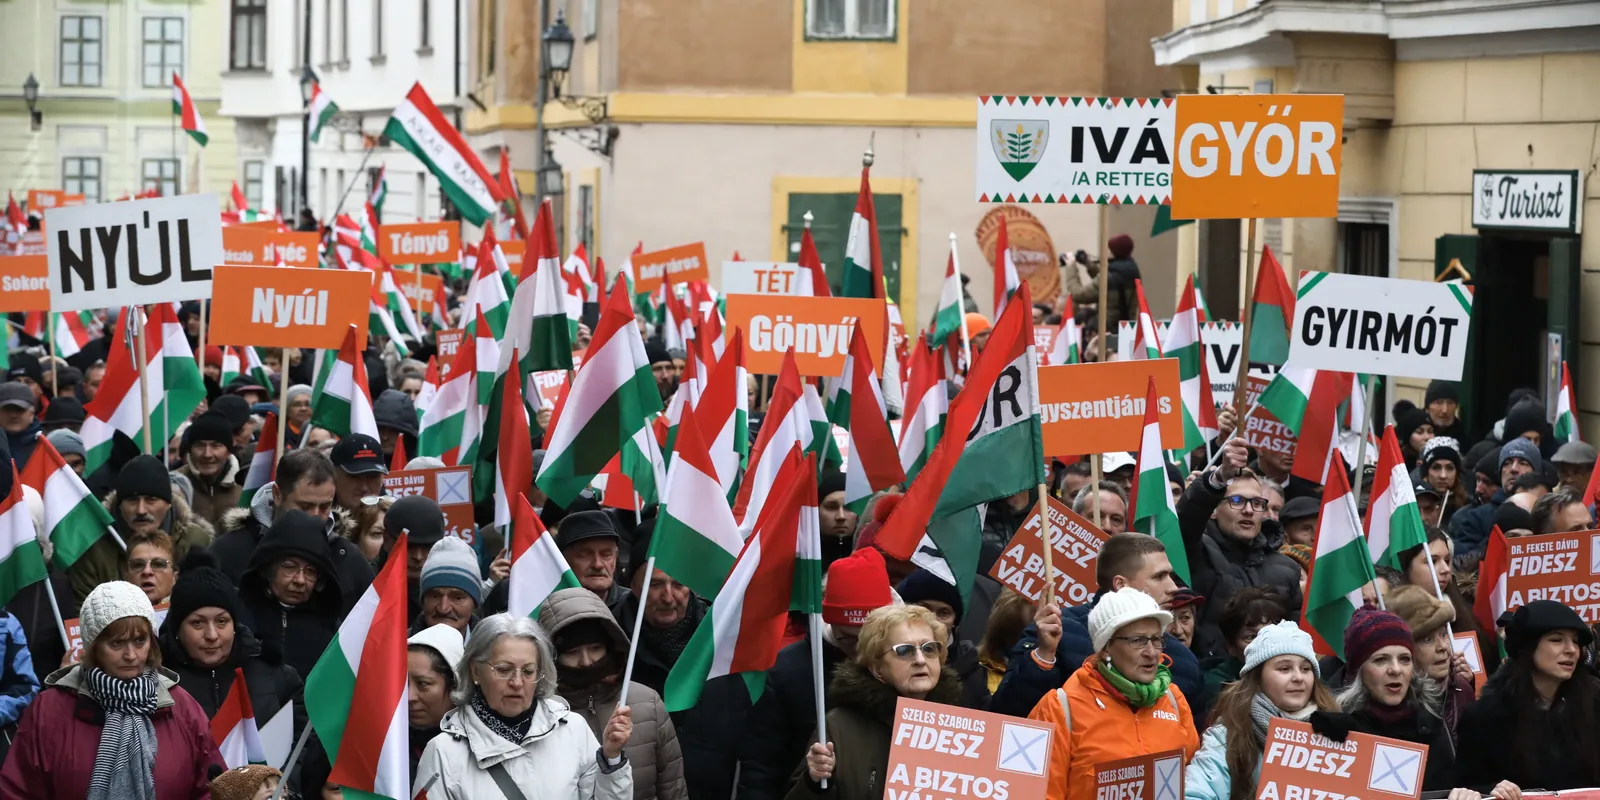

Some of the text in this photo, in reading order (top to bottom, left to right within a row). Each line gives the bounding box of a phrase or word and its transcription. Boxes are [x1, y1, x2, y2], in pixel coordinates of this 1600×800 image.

[1178, 105, 1336, 178] GYŐR
[1096, 171, 1173, 187] RETTEG
[1498, 176, 1564, 219] Turiszt
[58, 210, 212, 294] NYÚL
[389, 229, 449, 255] Tényő
[754, 265, 794, 293] TÉT
[251, 287, 328, 328] Nyúl
[749, 314, 857, 358] Gönyű
[1301, 305, 1459, 358] GYIRMÓT
[1040, 394, 1172, 425] gyszentjáns
[404, 474, 425, 486] DÁVID
[1047, 505, 1069, 527] ZELES
[1005, 543, 1025, 565] A
[1511, 537, 1579, 555] DR. FEKETE DÁVID
[1508, 551, 1579, 578] FIDESZ
[1508, 590, 1525, 609] A
[902, 707, 986, 733] SZELES SZABOLCS
[1152, 709, 1179, 722] FIDESZ
[894, 722, 984, 759] FIDESZ
[1273, 726, 1309, 744] SZELES
[1265, 741, 1357, 779] FIDESZ
[889, 763, 1009, 800] A BIZTOS
[1097, 764, 1145, 785] SZELES SZABOLCS
[1096, 779, 1145, 800] FIDESZ
[1259, 780, 1280, 800] A
